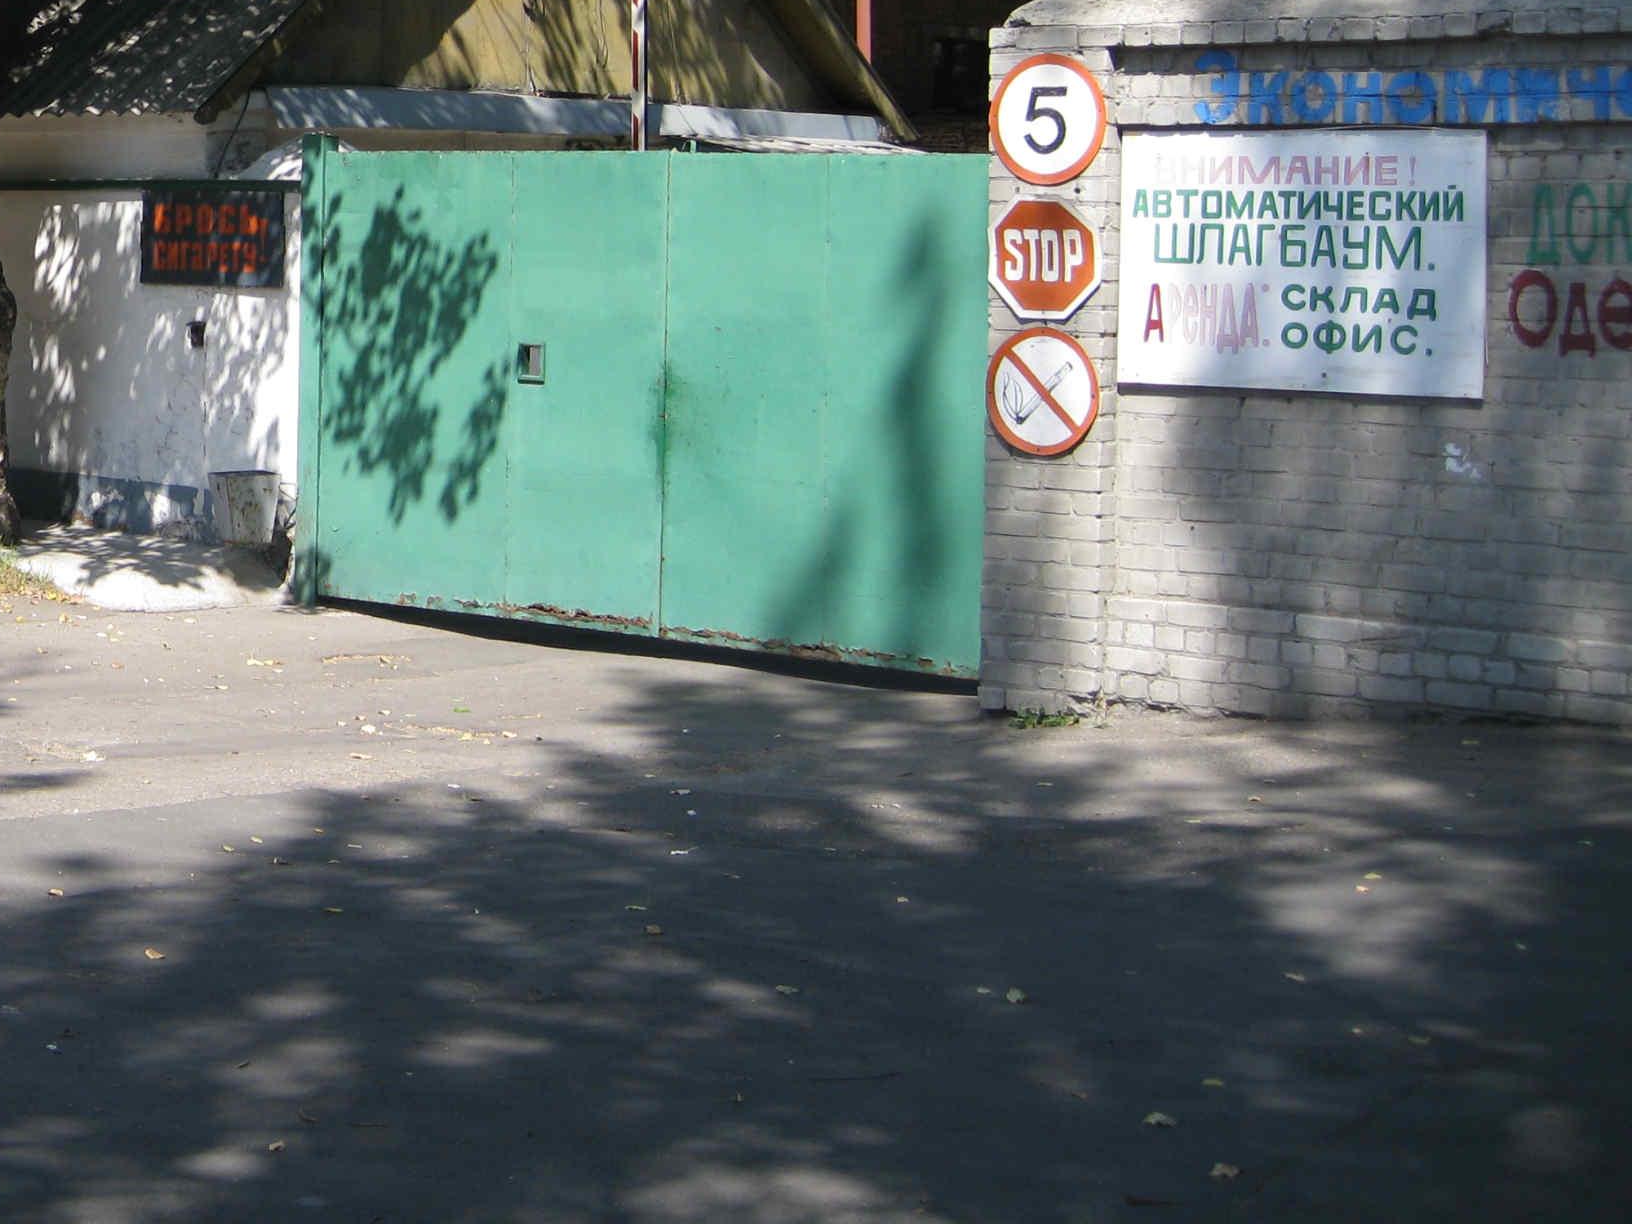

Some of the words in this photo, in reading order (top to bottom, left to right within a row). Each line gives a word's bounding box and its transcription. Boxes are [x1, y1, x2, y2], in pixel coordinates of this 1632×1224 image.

[1023, 86, 1068, 155] 5
[1132, 184, 1464, 222] АВТОМАТИЧЕСКИЙ
[1002, 228, 1084, 283] STOP
[1153, 223, 1436, 272] ШЛАГБАУМ.
[1280, 284, 1437, 322] СКЛАД
[1280, 319, 1433, 358] ОФИС.
